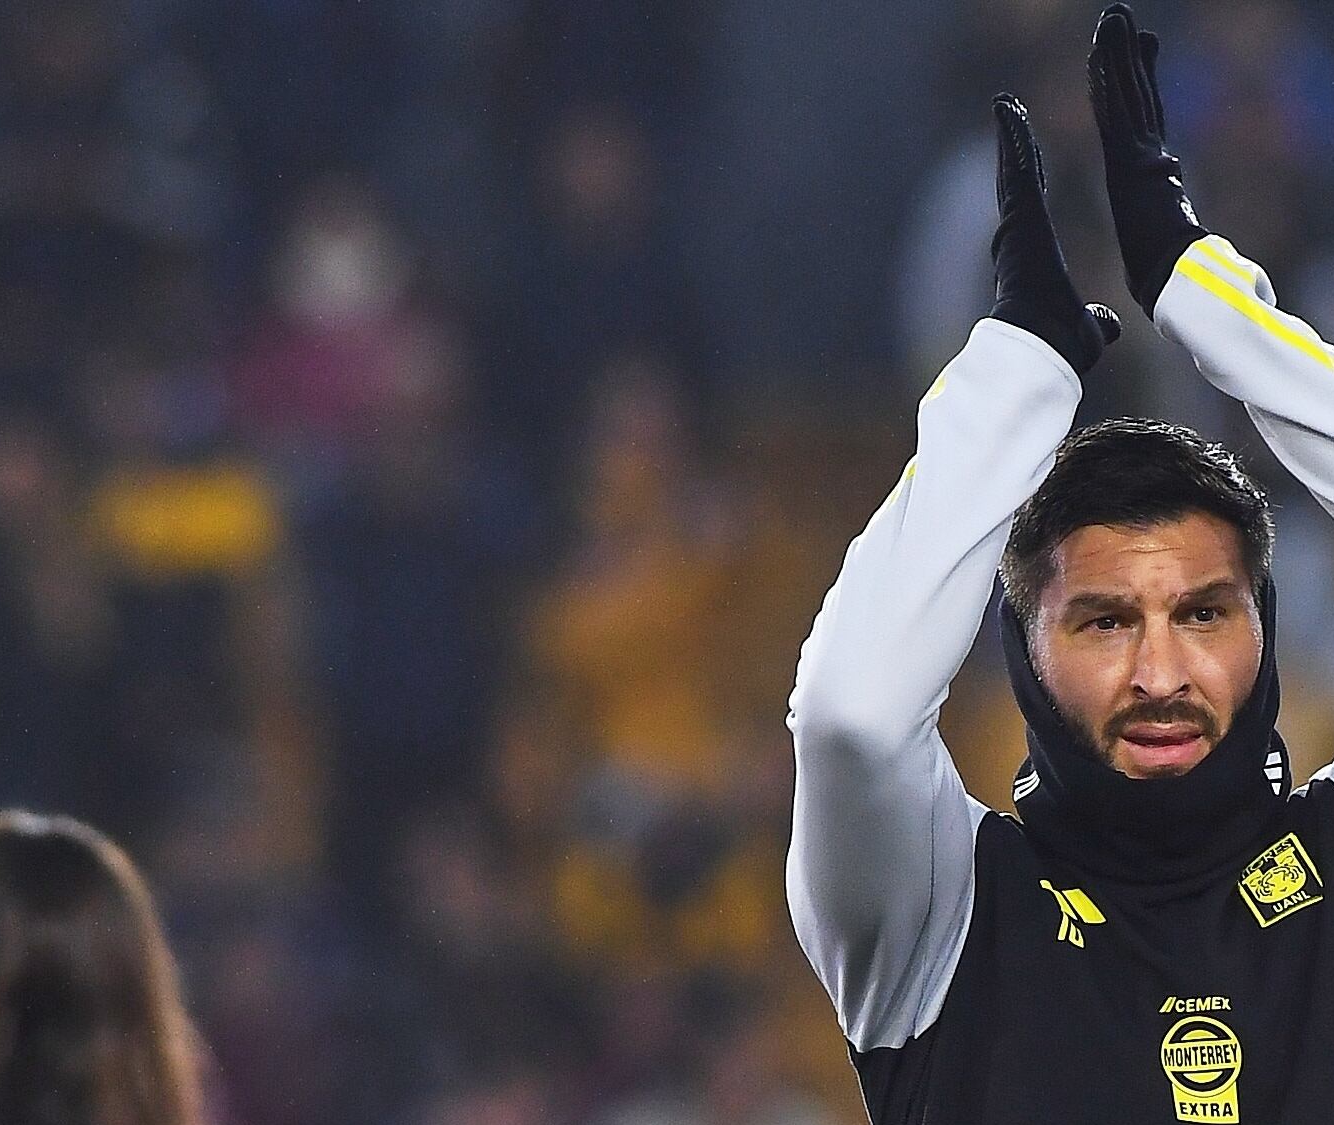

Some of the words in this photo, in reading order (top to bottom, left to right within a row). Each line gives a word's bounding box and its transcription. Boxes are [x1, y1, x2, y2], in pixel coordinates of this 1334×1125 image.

[1272, 890, 1311, 913] UANL
[1174, 996, 1232, 1013] CEMEX
[1163, 1043, 1238, 1067] MONTERREY
[1179, 1102, 1233, 1117] EXTRA
